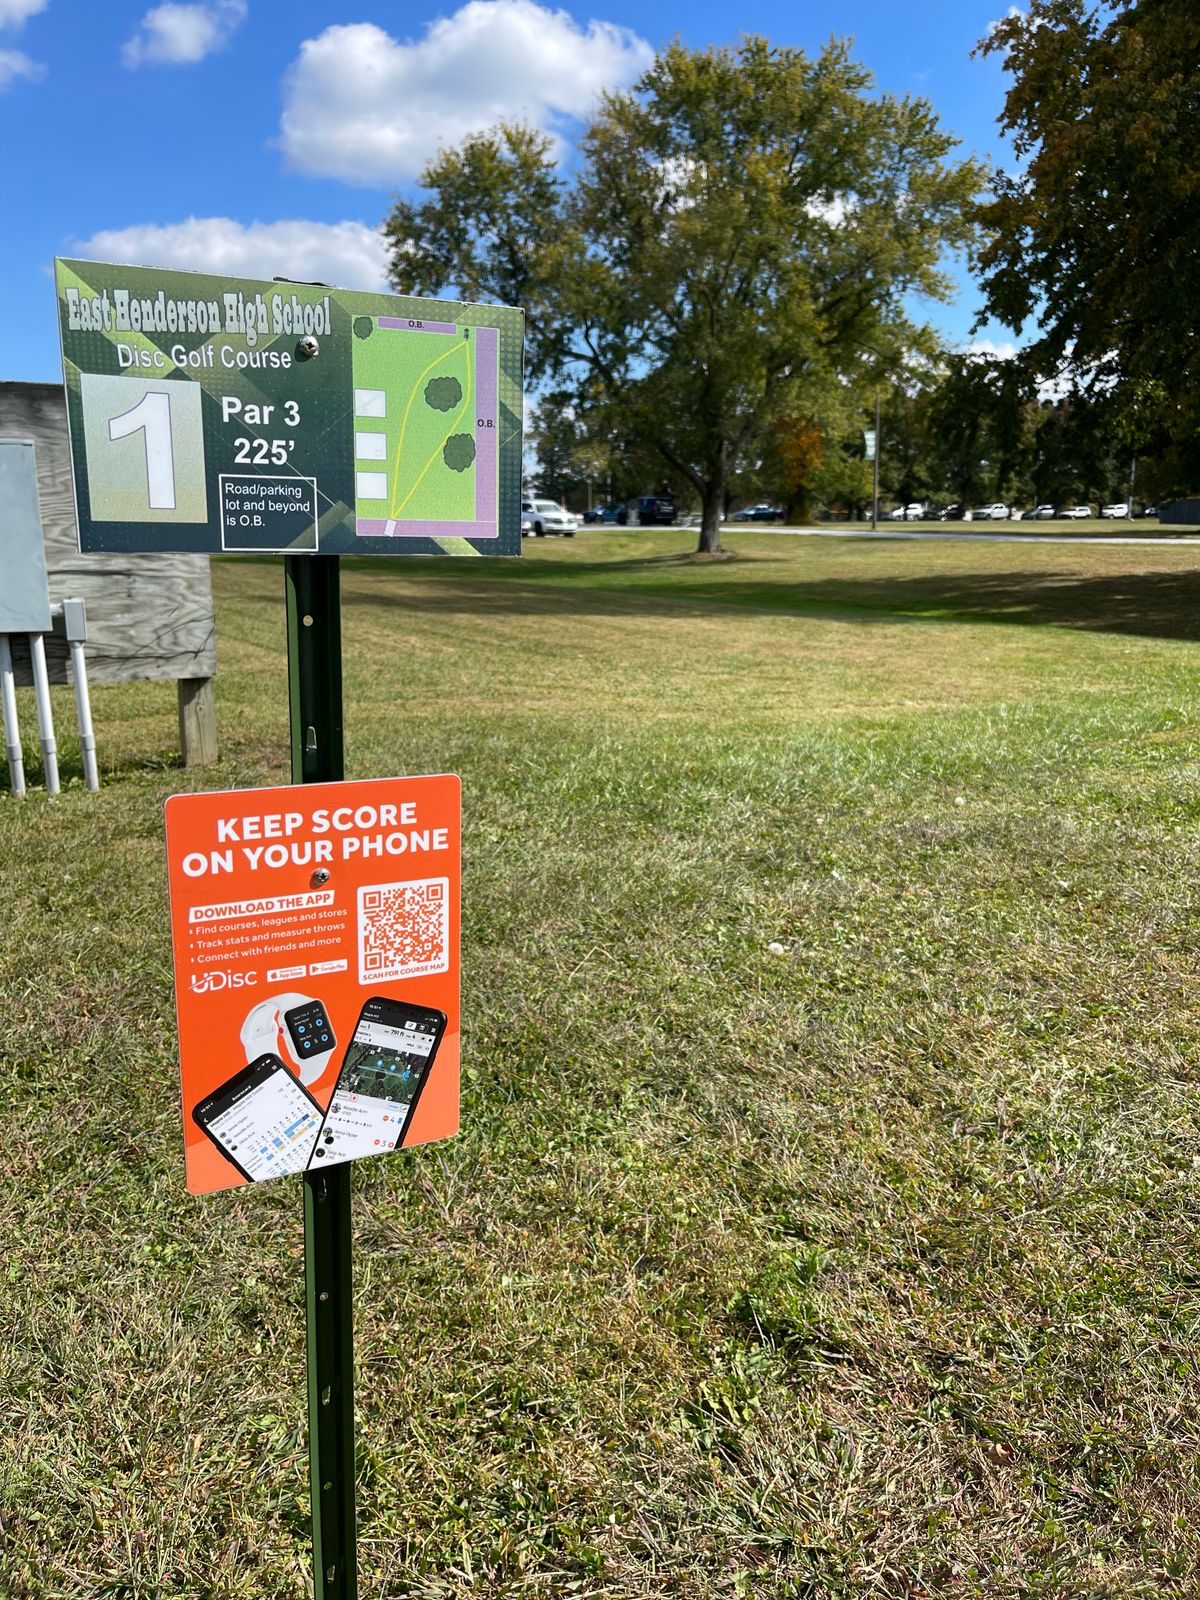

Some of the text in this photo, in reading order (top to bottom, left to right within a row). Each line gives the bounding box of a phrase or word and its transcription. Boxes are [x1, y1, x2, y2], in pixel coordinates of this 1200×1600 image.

[65, 288, 331, 346] East Henderson High School
[408, 320, 425, 329] O.B.
[117, 344, 292, 368] Disc Golf Course
[222, 396, 301, 427] Par 3
[477, 418, 496, 428] O.B.
[108, 392, 176, 509] 1
[225, 482, 302, 498] Road/parking
[225, 499, 310, 515] lot and beyond
[226, 514, 266, 527] is O.B.
[217, 802, 417, 843] KEEP SCORE
[182, 828, 449, 878] ON YOUR PHONE
[194, 893, 331, 920] DOWNLOAD THE APP
[196, 908, 347, 935] Find courses, leagues and stores
[196, 922, 345, 949] Track stats and measure throws
[197, 936, 342, 964] Connect with friends and more
[188, 969, 258, 993] UDisc
[362, 963, 445, 981] SCAN FOR COURSE MAP
